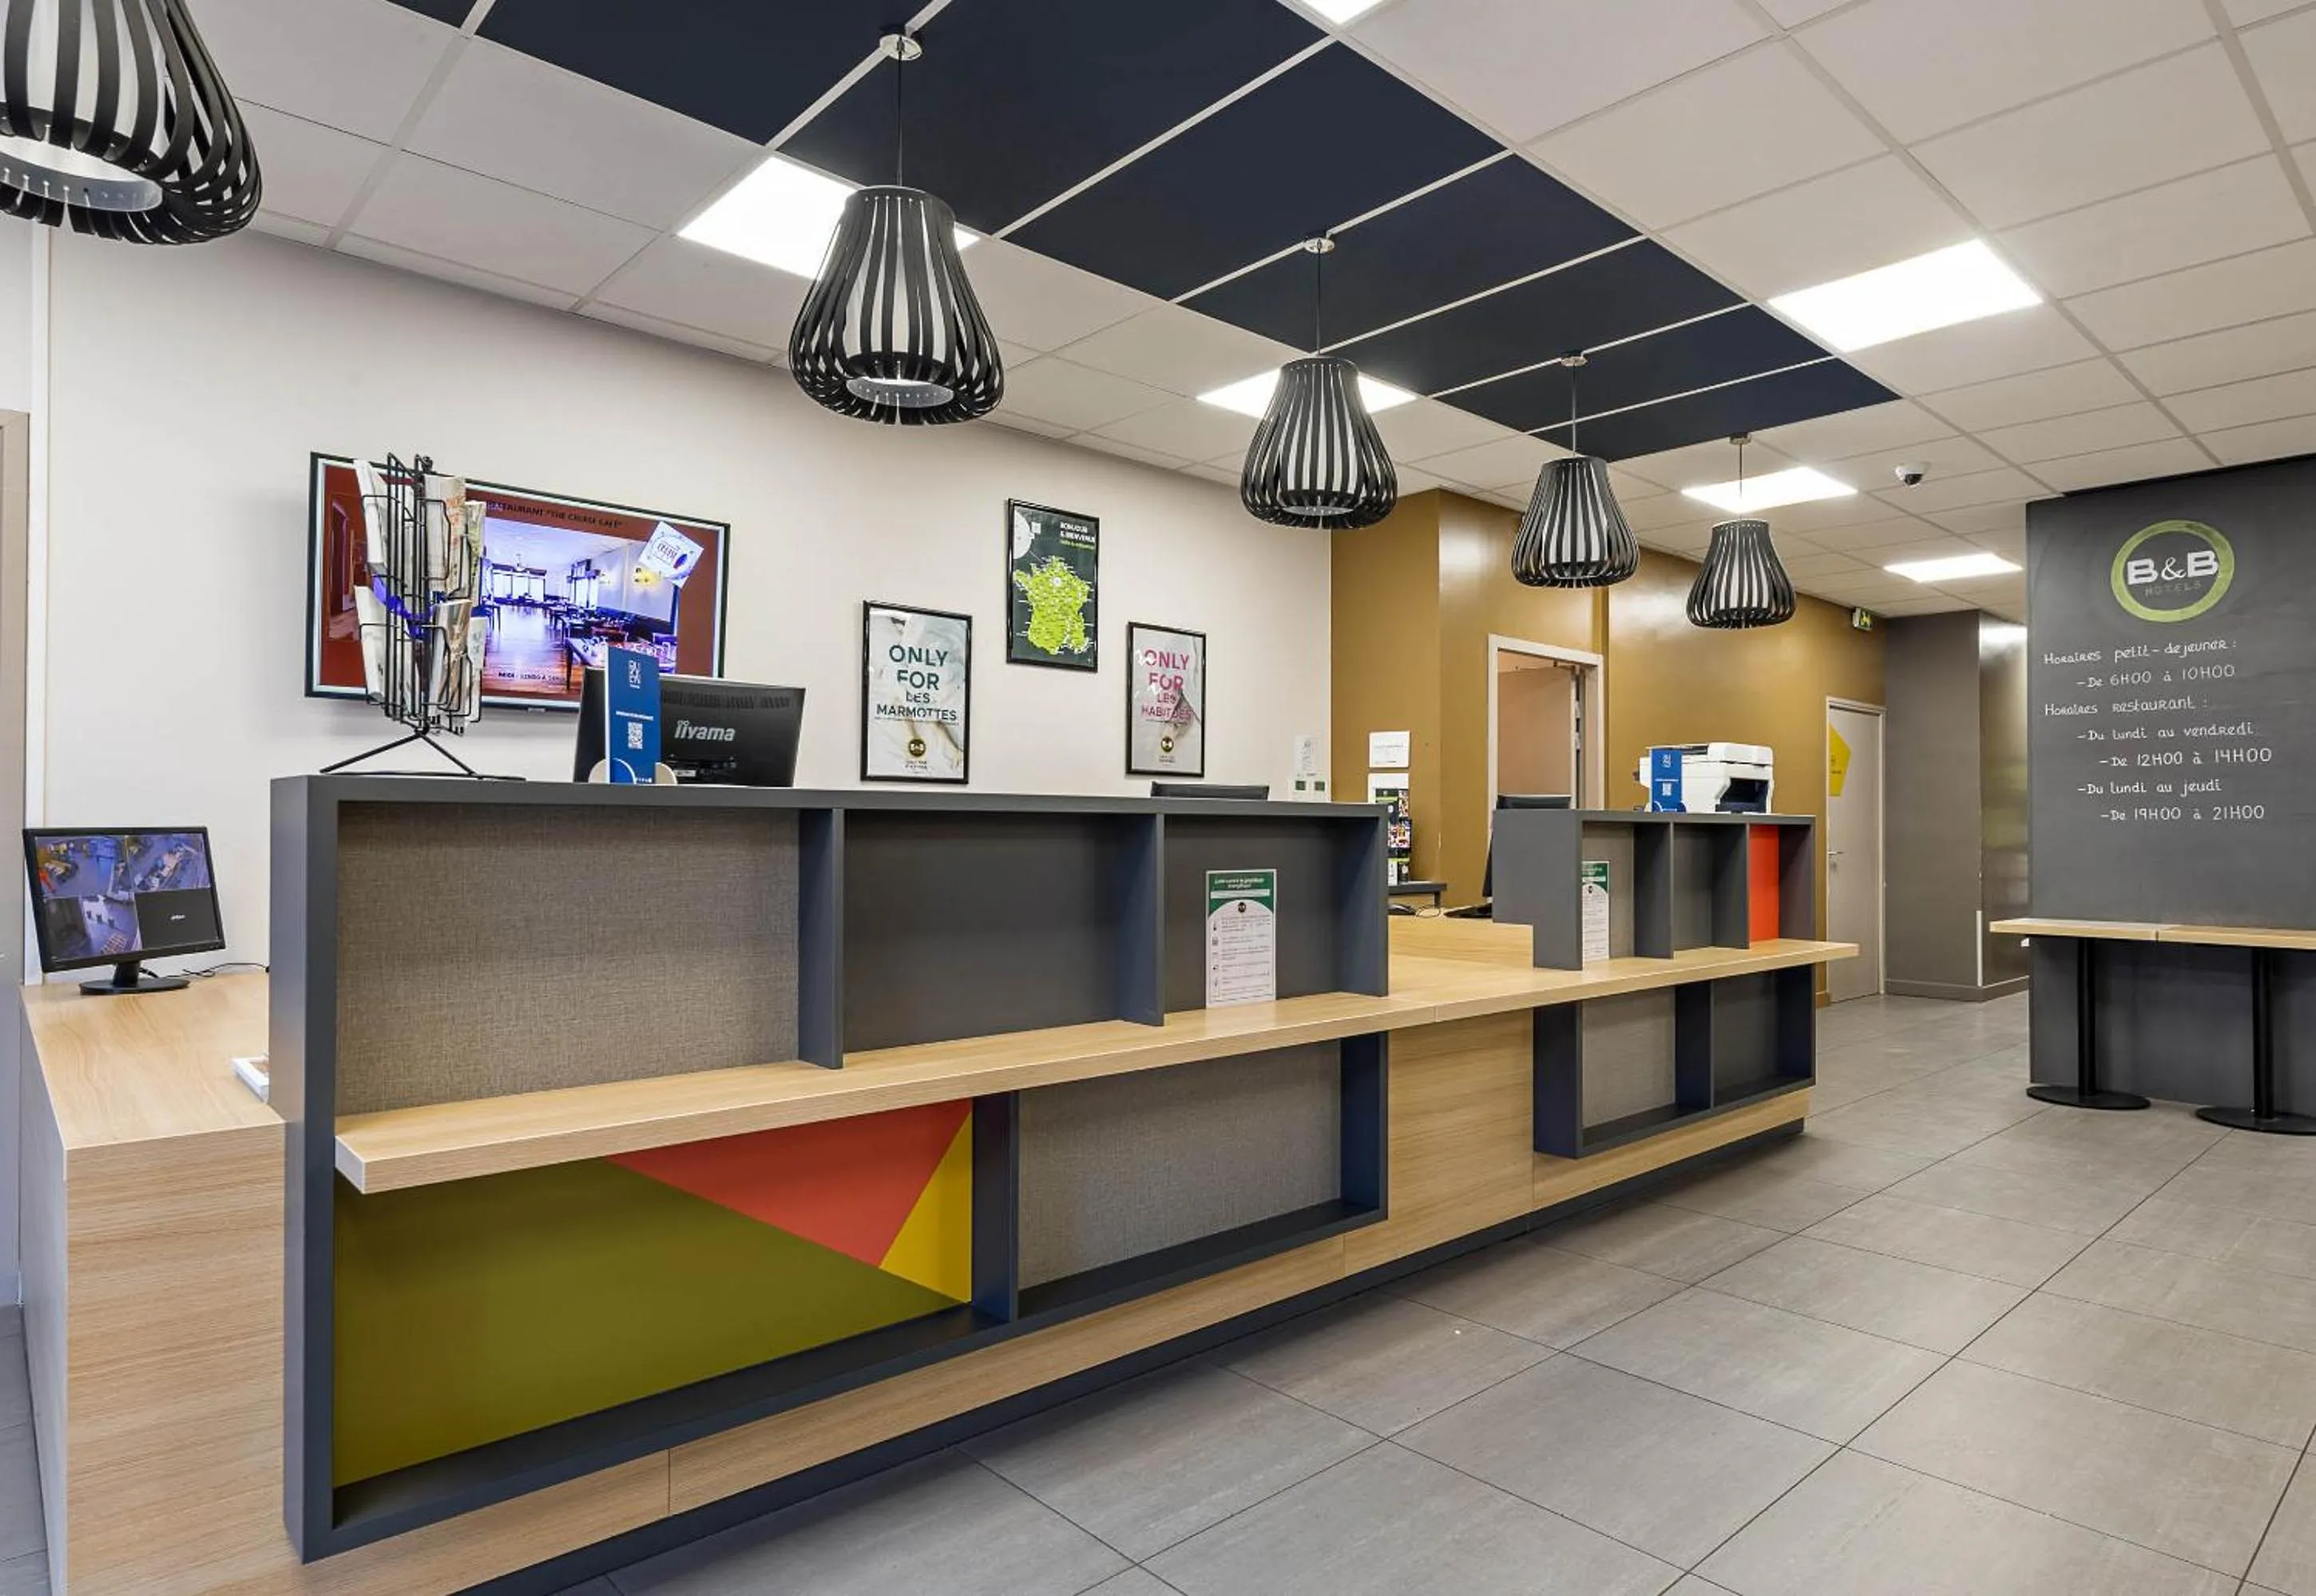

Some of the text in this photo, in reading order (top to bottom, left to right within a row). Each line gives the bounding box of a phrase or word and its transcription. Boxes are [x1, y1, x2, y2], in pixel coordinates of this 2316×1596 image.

[2127, 550, 2219, 585] B&B
[2144, 580, 2203, 597] HOTELS
[889, 644, 950, 667] ONLY
[1144, 649, 1190, 671] ONLY
[897, 669, 940, 691] FOR
[1148, 672, 1184, 691] FOR
[2110, 671, 2152, 686] 6H00
[2163, 671, 2173, 683] à
[2182, 664, 2235, 679] 10H00
[906, 691, 931, 704] LES
[1157, 693, 1176, 703] LES
[875, 703, 958, 722] MARMOTTES
[674, 720, 736, 743] iiyama
[2112, 727, 2147, 739] lundi
[2158, 728, 2175, 738] au
[2183, 722, 2254, 737] vendredi
[2136, 751, 2183, 766] 12H00
[2192, 752, 2203, 765] à
[2214, 747, 2272, 764] 14H00
[2110, 782, 2147, 794] lundi
[2156, 783, 2173, 793] au
[2180, 778, 2223, 797] jeudi
[2134, 806, 2182, 821] 19H00
[2192, 808, 2202, 820] à
[2212, 805, 2265, 821] 21H00
